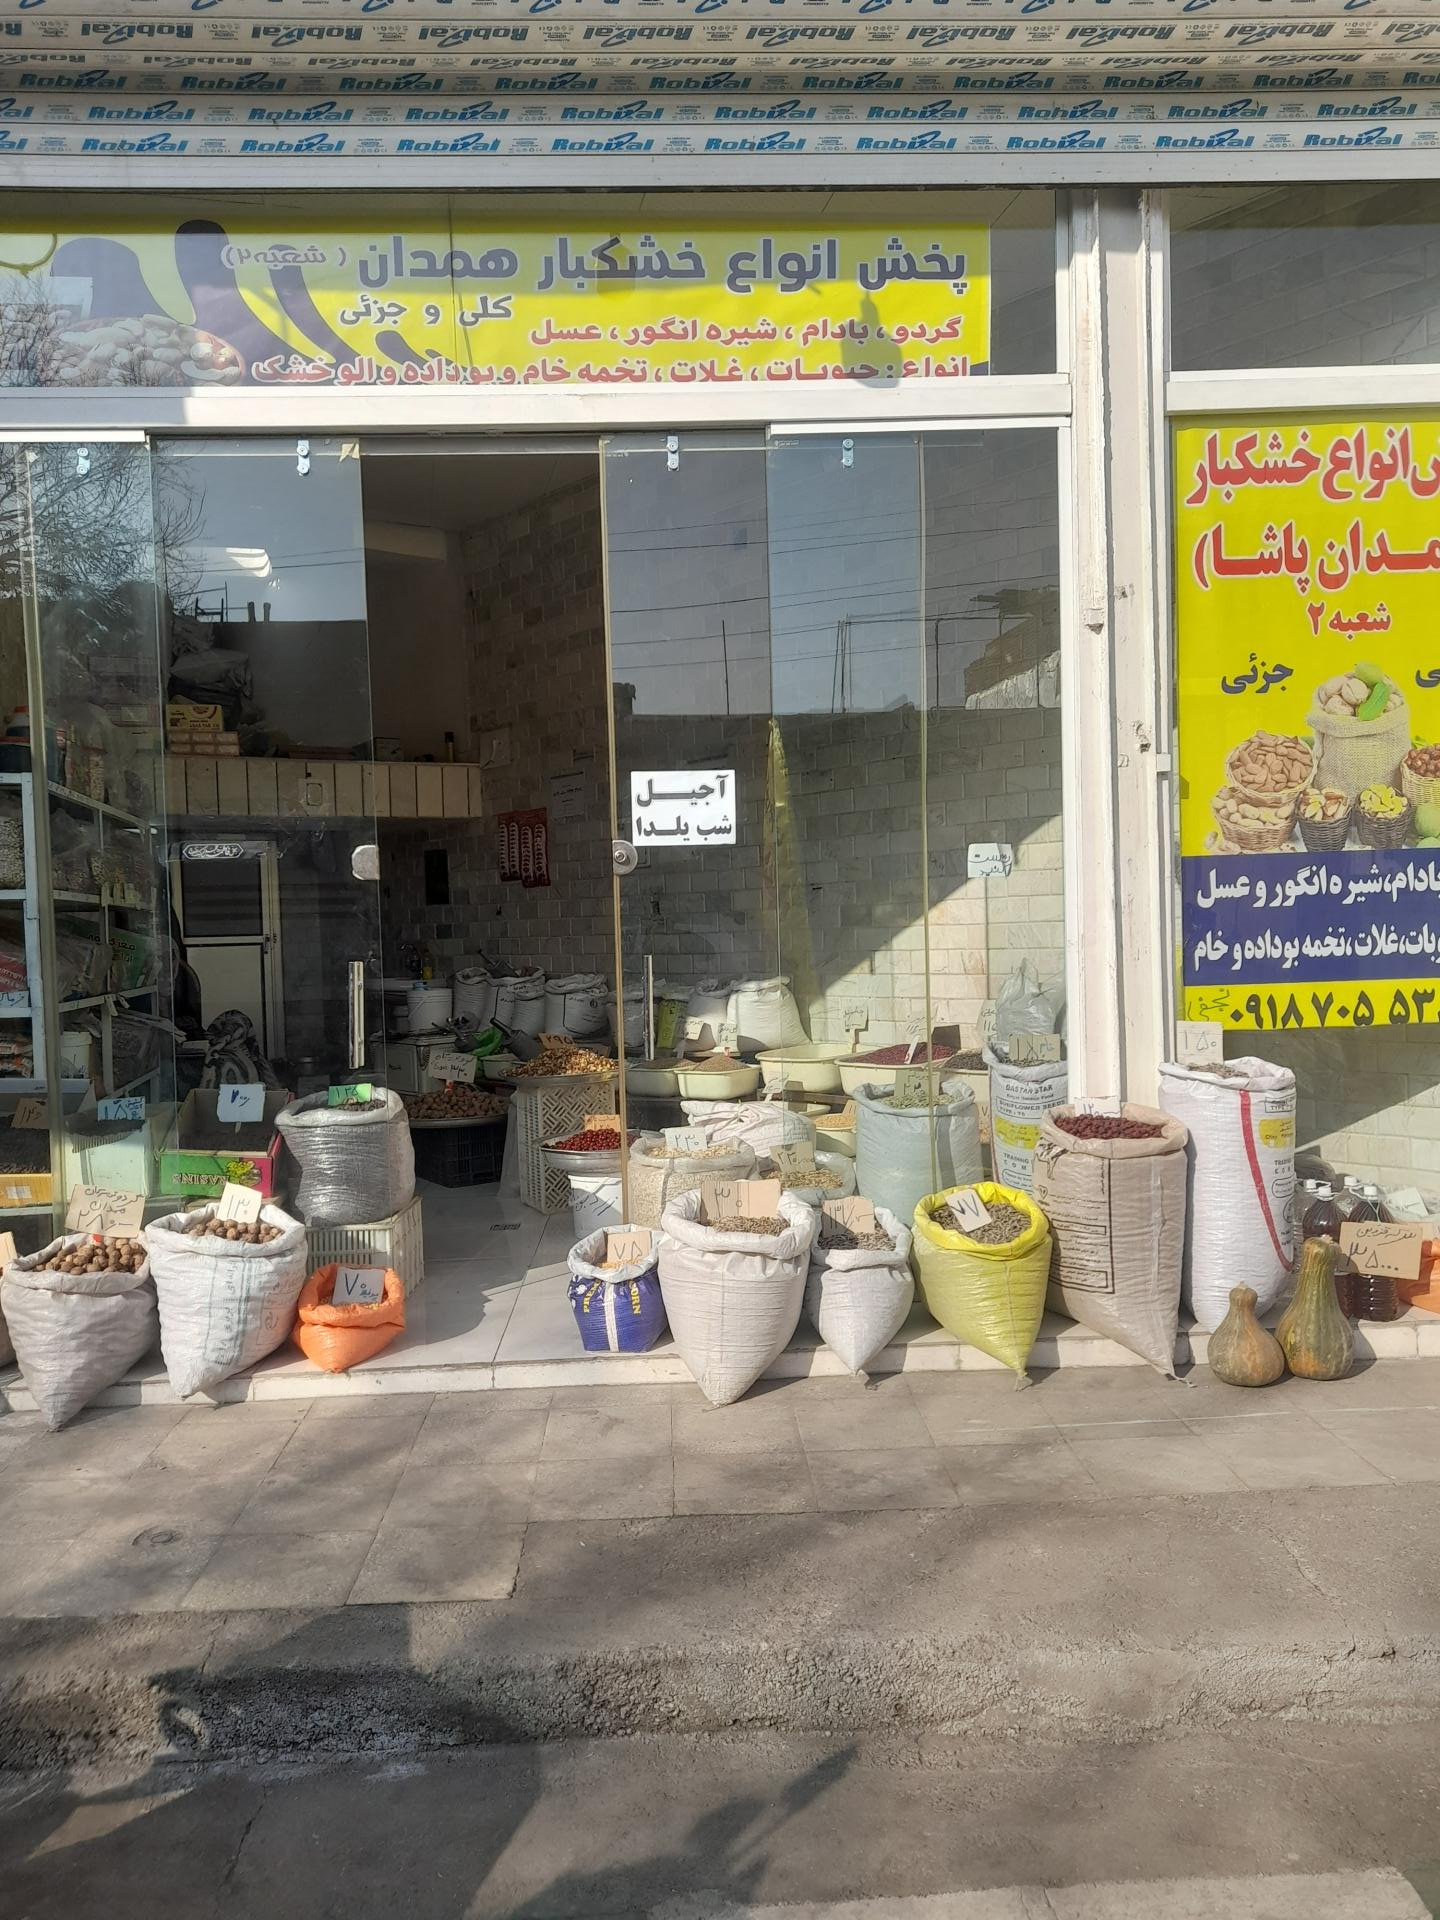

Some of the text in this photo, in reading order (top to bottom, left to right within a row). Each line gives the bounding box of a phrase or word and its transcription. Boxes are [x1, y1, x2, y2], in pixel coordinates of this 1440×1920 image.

[358, 236, 519, 288] همدان
[538, 235, 705, 289] خشکبار
[727, 237, 838, 292] انواع
[858, 236, 966, 294] پخش
[340, 294, 512, 327] کلی و جزئی
[531, 319, 602, 345] عسل
[625, 316, 698, 346] انگور
[706, 318, 777, 345] شیره
[802, 319, 869, 346] بادام
[892, 316, 962, 344] گردو
[252, 357, 335, 382] خشک
[1186, 430, 1321, 504] خشکبار
[1322, 426, 1411, 500] انواع
[1307, 602, 1391, 640] شعبه ۲
[1221, 652, 1294, 694] جزئی
[637, 774, 730, 808] آجیل
[636, 815, 732, 842] شب یلدا
[1197, 868, 1250, 909] عسل
[1252, 879, 1267, 908] و
[1269, 864, 1327, 908] انگور
[1194, 930, 1229, 971] خام
[1231, 943, 1243, 970] و
[1302, 926, 1345, 958] تخمه
[1389, 989, 1440, 1024] ۵۳
